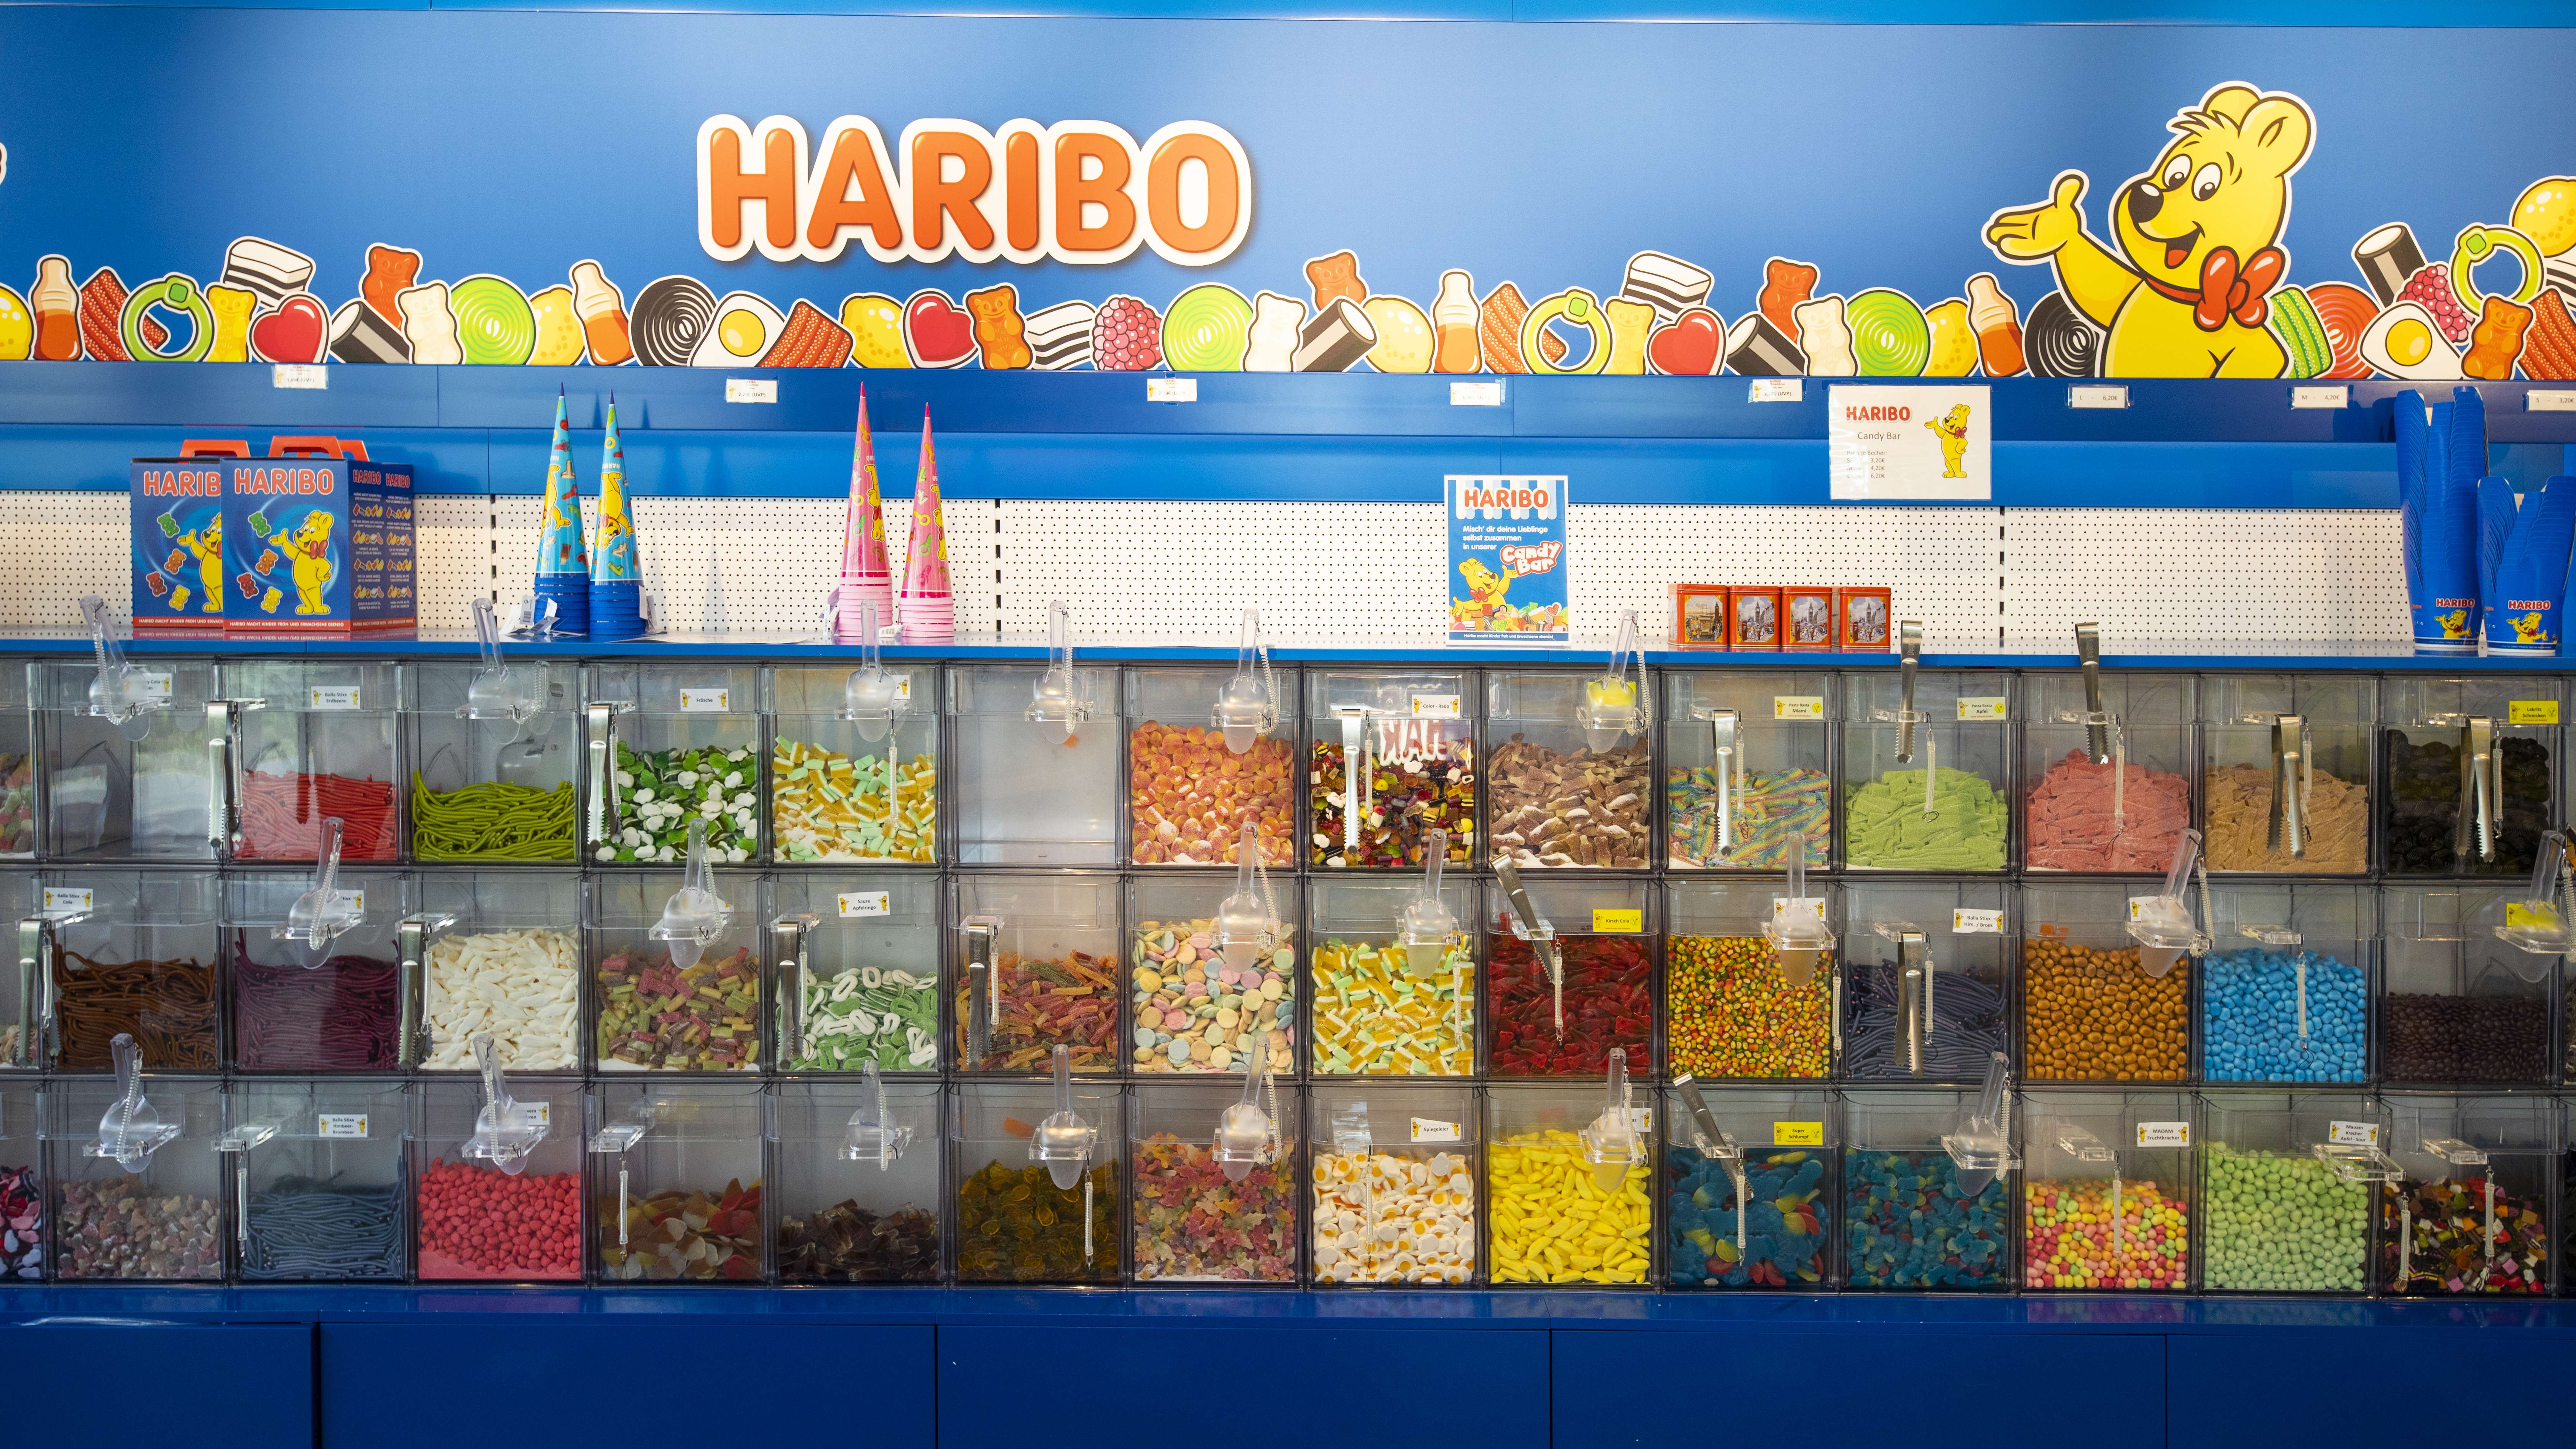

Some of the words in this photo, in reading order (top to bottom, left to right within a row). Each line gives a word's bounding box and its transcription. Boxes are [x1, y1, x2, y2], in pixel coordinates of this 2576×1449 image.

[705, 122, 1244, 258] HARIBO
[1846, 406, 1911, 421] HARIBO
[1858, 432, 1884, 440] Candy
[144, 471, 221, 496] HARIB
[234, 467, 334, 496] HARIBO
[353, 469, 381, 485] HARIBO
[386, 473, 410, 488] HARIBO
[1463, 489, 1550, 509] HARIBO
[1502, 542, 1561, 562] Candy
[1516, 558, 1554, 574] Bar
[2435, 598, 2475, 608] HARIBO
[2508, 600, 2551, 610] HARIBO
